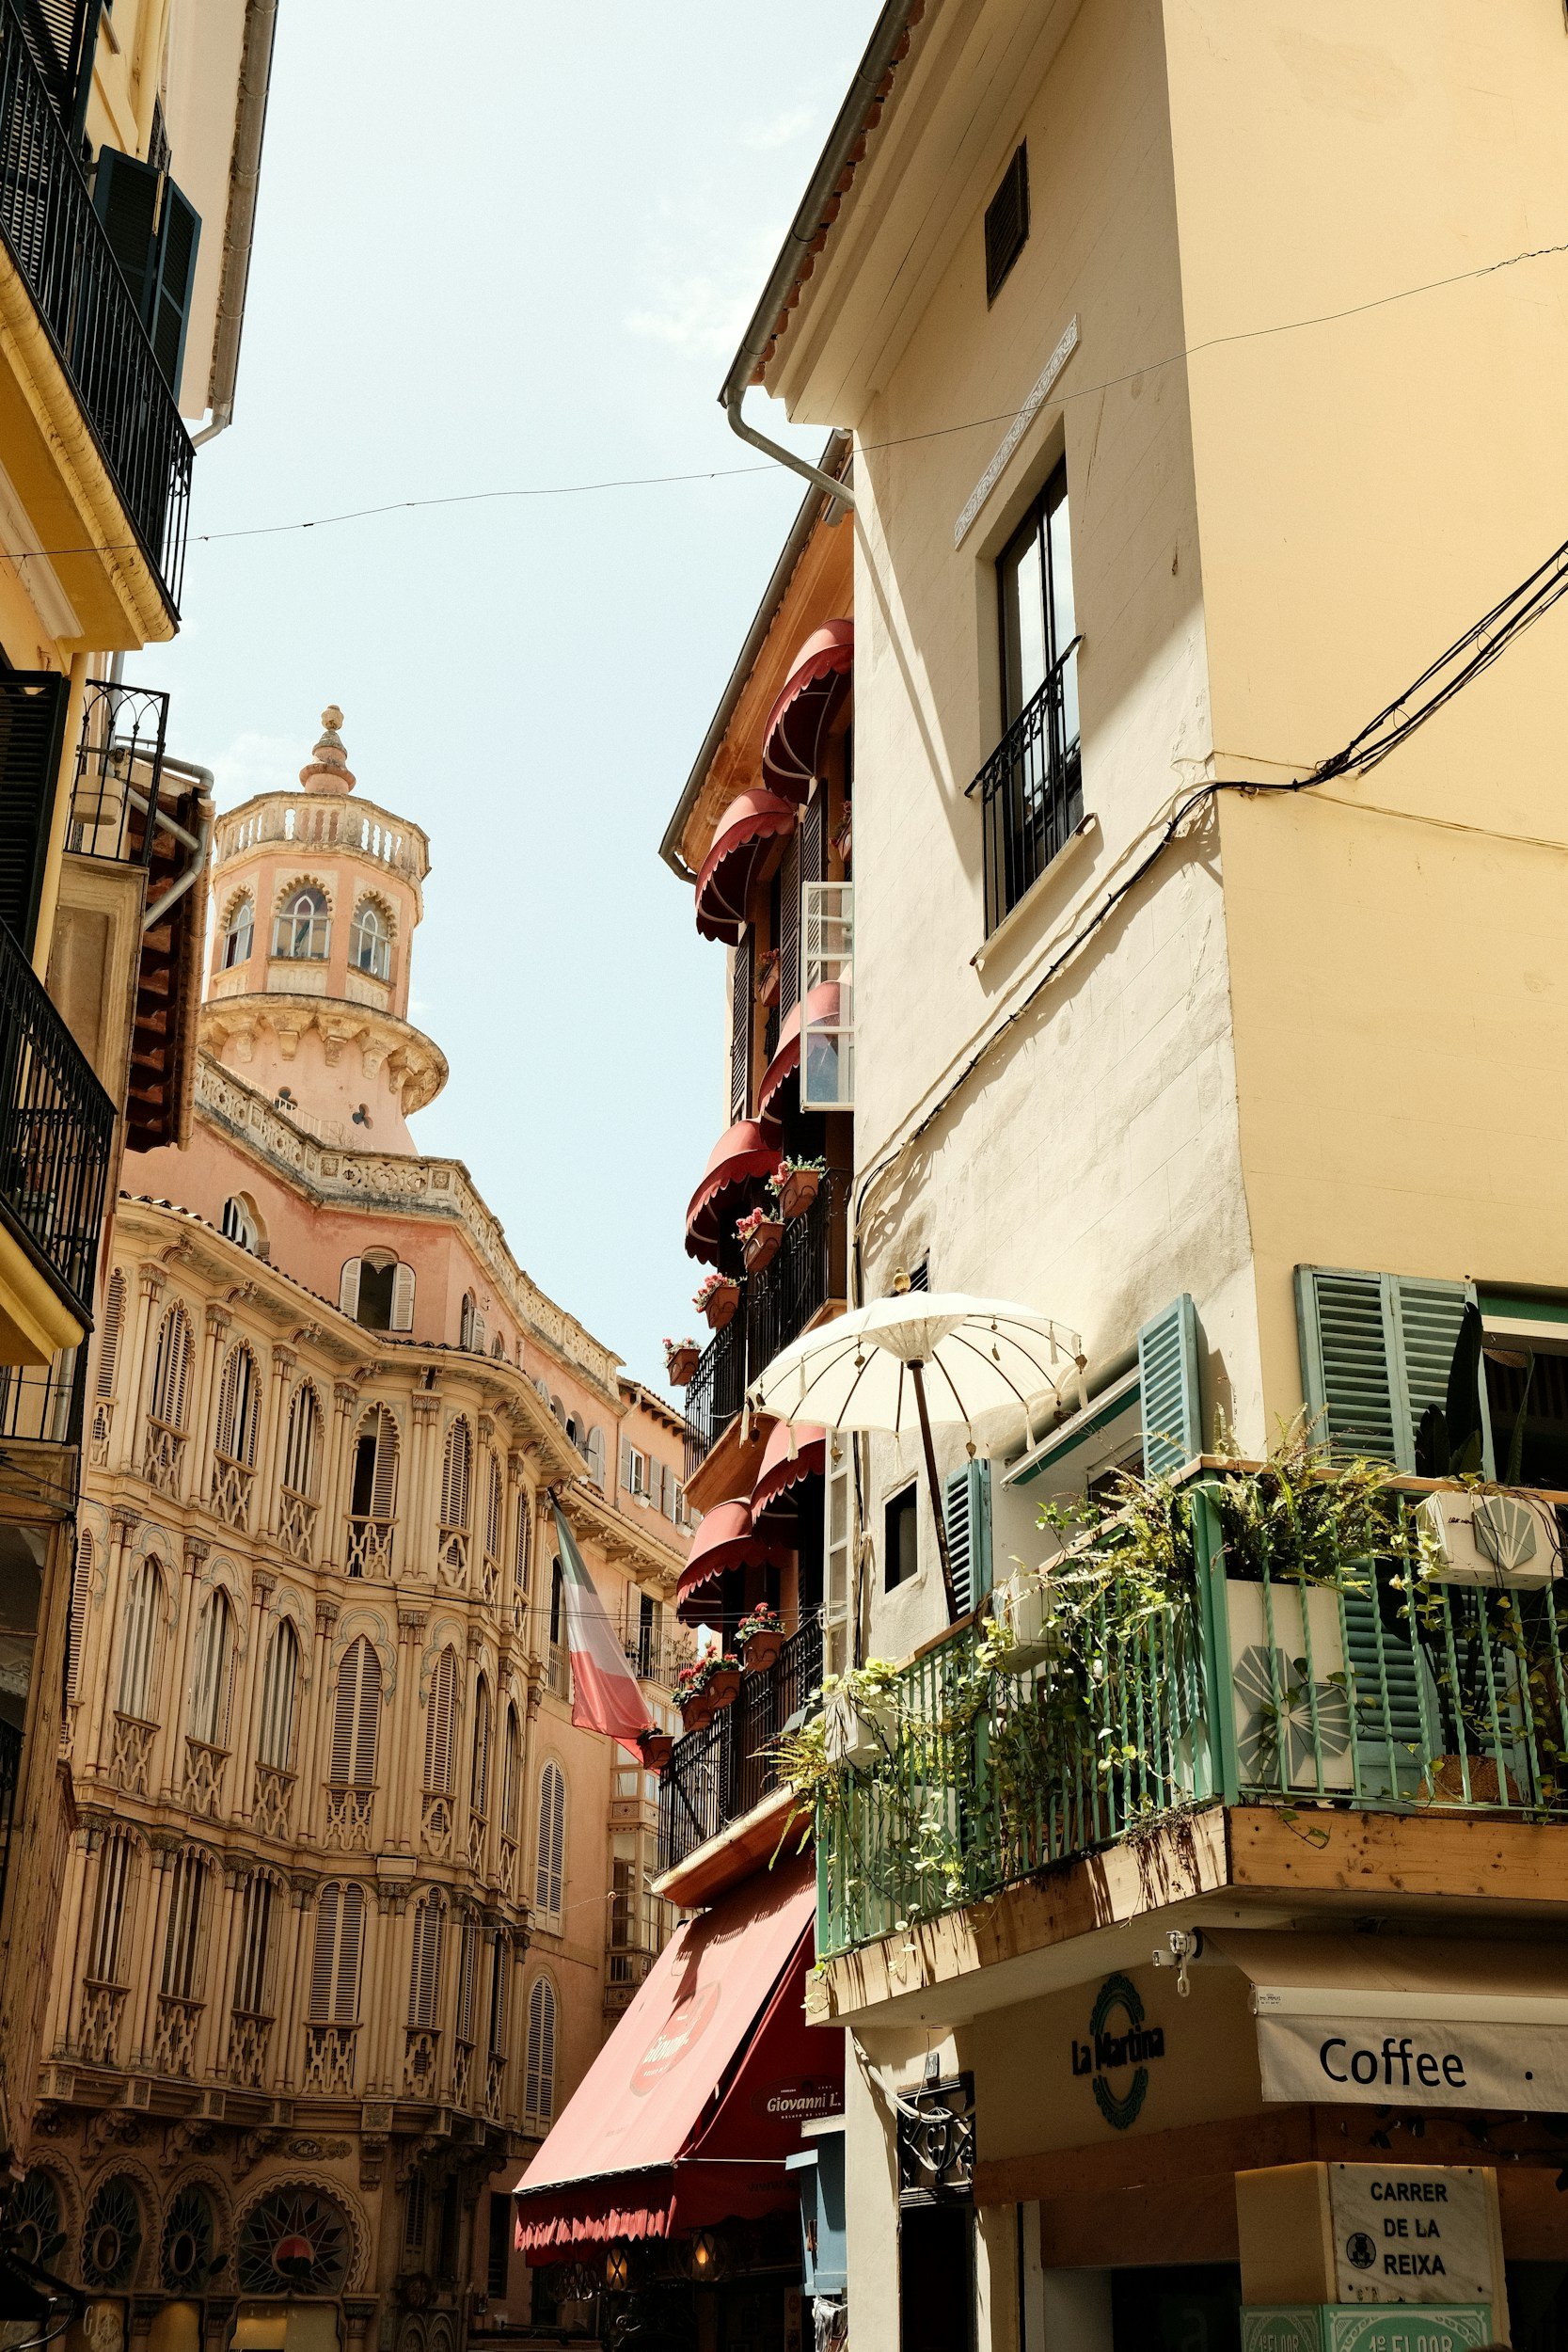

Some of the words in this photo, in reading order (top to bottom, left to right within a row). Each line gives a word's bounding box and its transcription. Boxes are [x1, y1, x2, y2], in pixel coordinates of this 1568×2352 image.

[1072, 2040, 1092, 2075] La
[1095, 2025, 1164, 2071] Martina
[1320, 2038, 1467, 2088] Coffee
[767, 2093, 826, 2113] Giovanni
[1370, 2182, 1449, 2202] CARRER
[1384, 2218, 1409, 2237] DE
[1416, 2218, 1440, 2238] LA
[1384, 2254, 1446, 2276] REIXA
